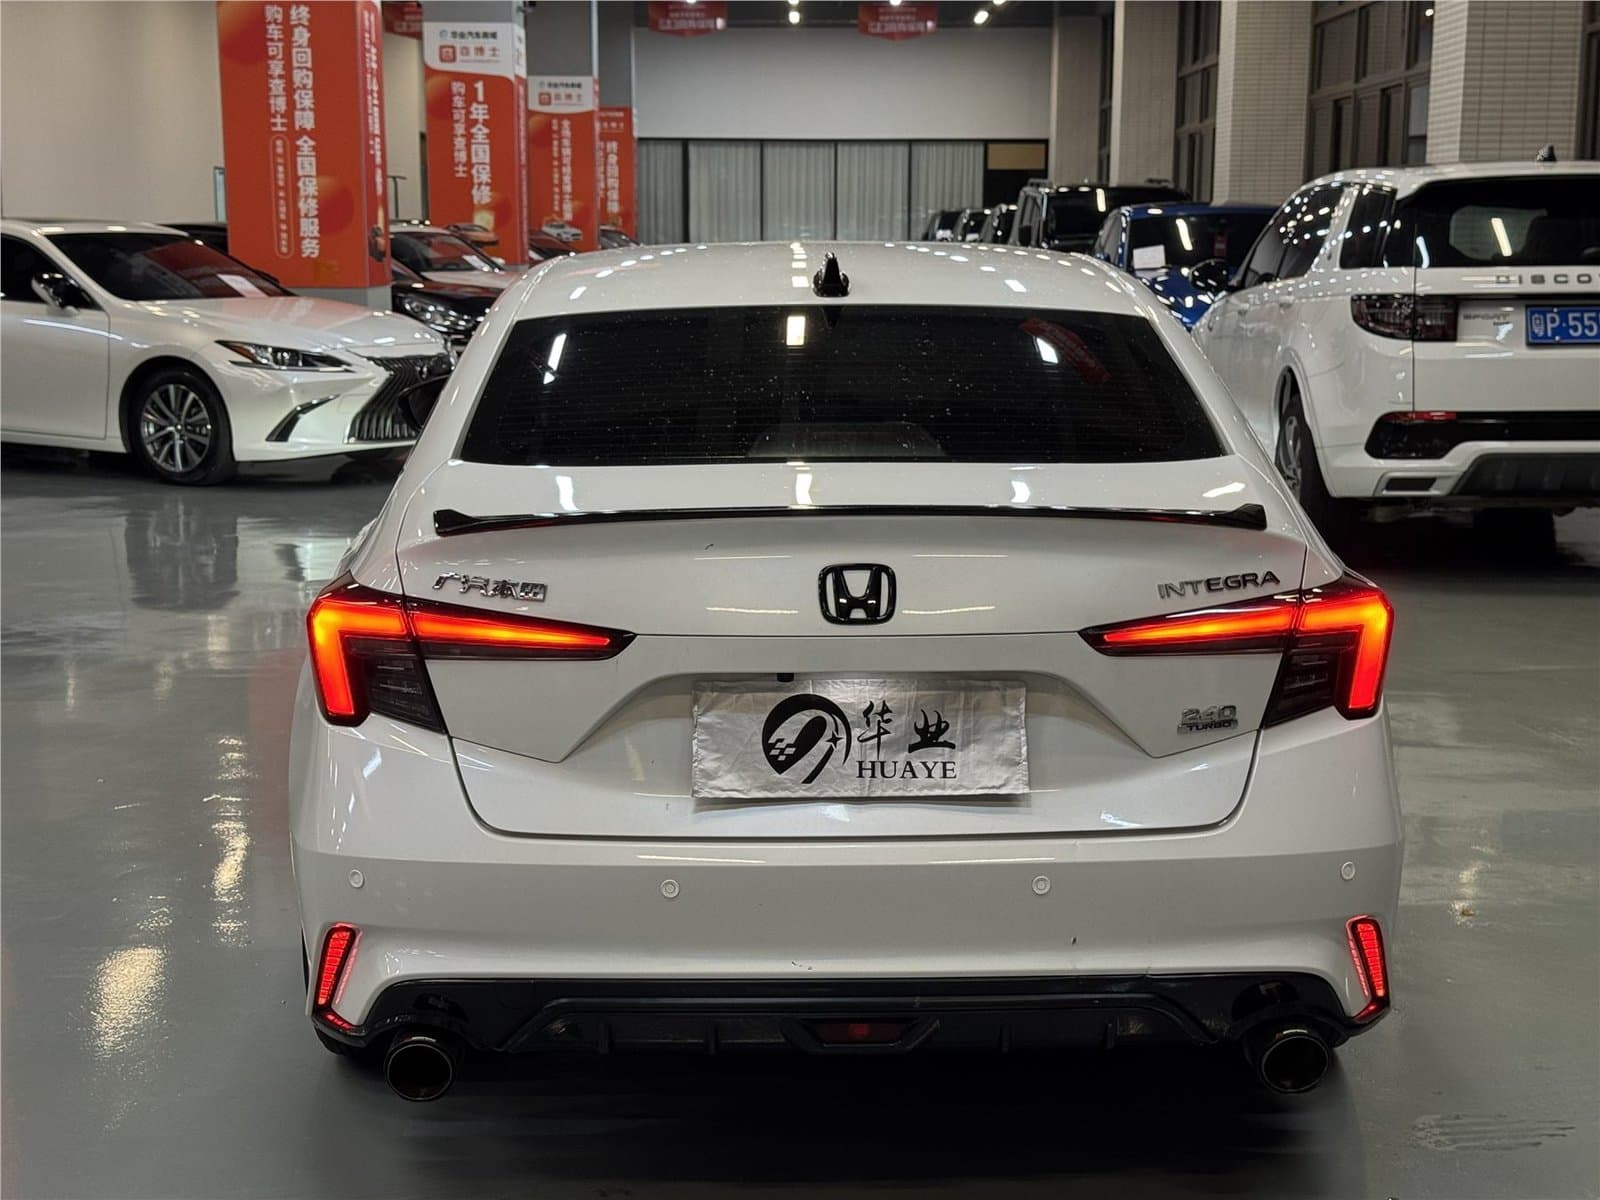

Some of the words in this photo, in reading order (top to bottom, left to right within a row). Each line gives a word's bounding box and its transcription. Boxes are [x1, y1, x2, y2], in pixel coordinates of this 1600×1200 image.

[264, 4, 287, 131] 购车可享查博士
[290, 5, 316, 130] 终身回购保障
[469, 81, 492, 205] 1年全国保修
[295, 135, 319, 258] 全国保修服务
[1496, 274, 1600, 284] DISCO
[432, 572, 548, 602] 广汽本田
[1157, 570, 1280, 599] INTEGRA
[1182, 705, 1237, 720] 240
[1186, 719, 1233, 731] TURBO
[856, 700, 956, 760] 华业
[856, 760, 957, 779] HUAYE
